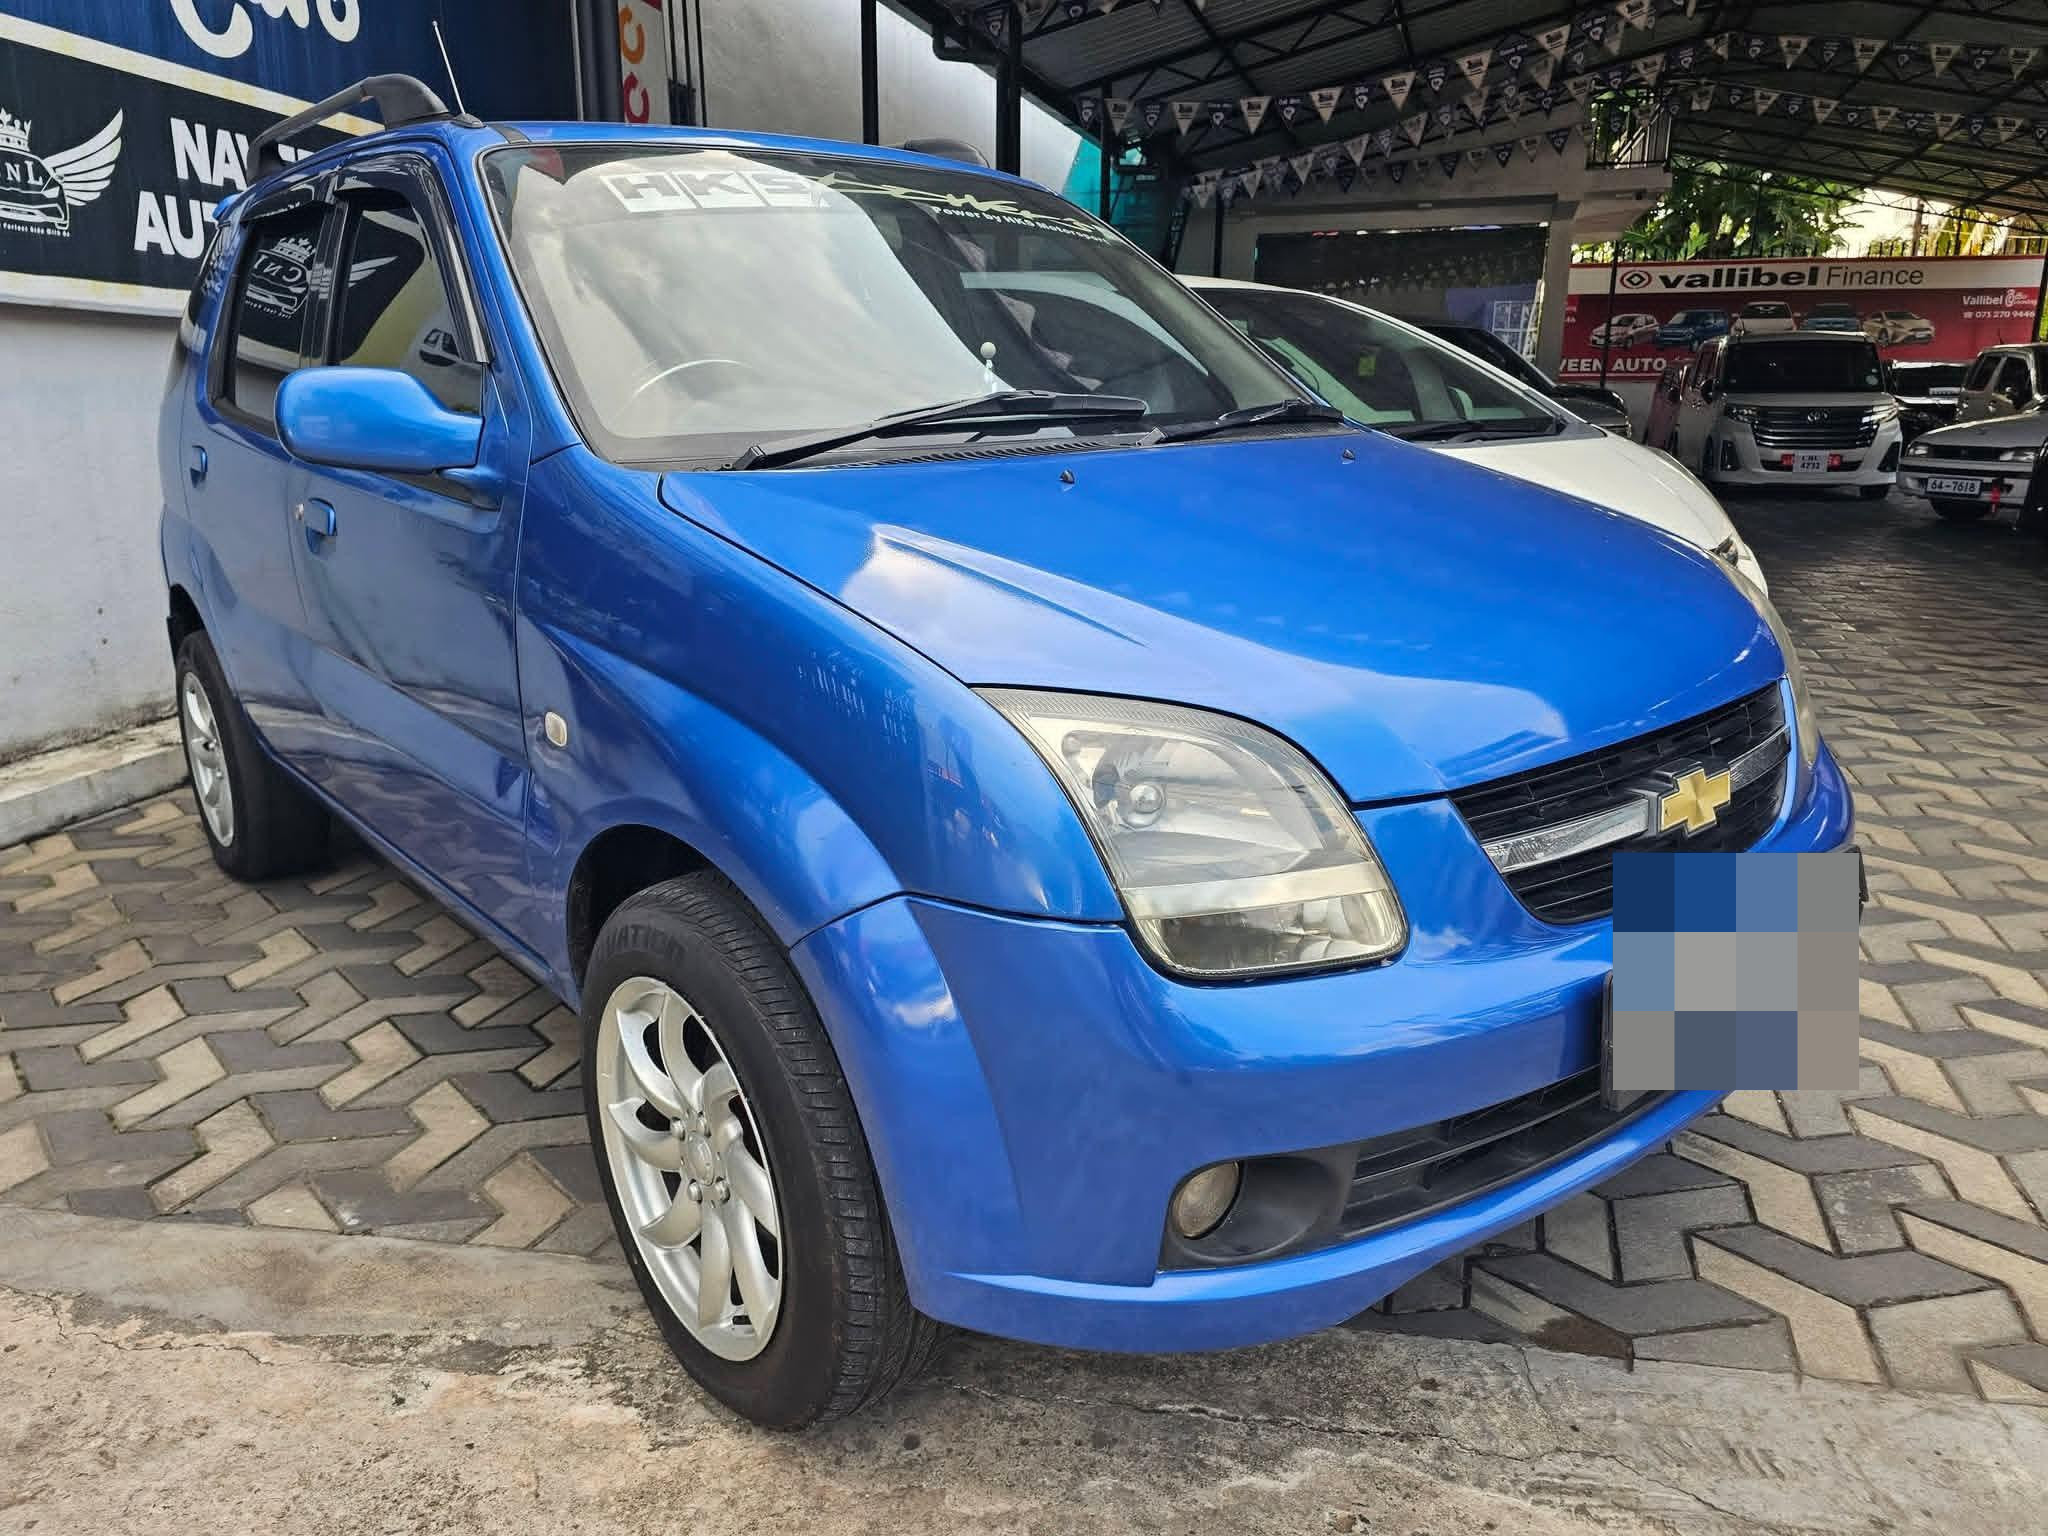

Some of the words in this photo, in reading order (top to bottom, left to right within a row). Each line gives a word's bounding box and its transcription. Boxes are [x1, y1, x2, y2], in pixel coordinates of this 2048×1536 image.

[600, 170, 820, 213] HKS
[933, 206, 981, 218] Power
[982, 212, 1001, 223] by
[1002, 214, 1036, 227] HKS
[1658, 266, 1819, 289] vallibel
[1826, 265, 1924, 286] Finance
[1962, 295, 2003, 305] Vallibel
[1611, 358, 1667, 372] AUTO
[1930, 478, 1977, 492] 64-7618
